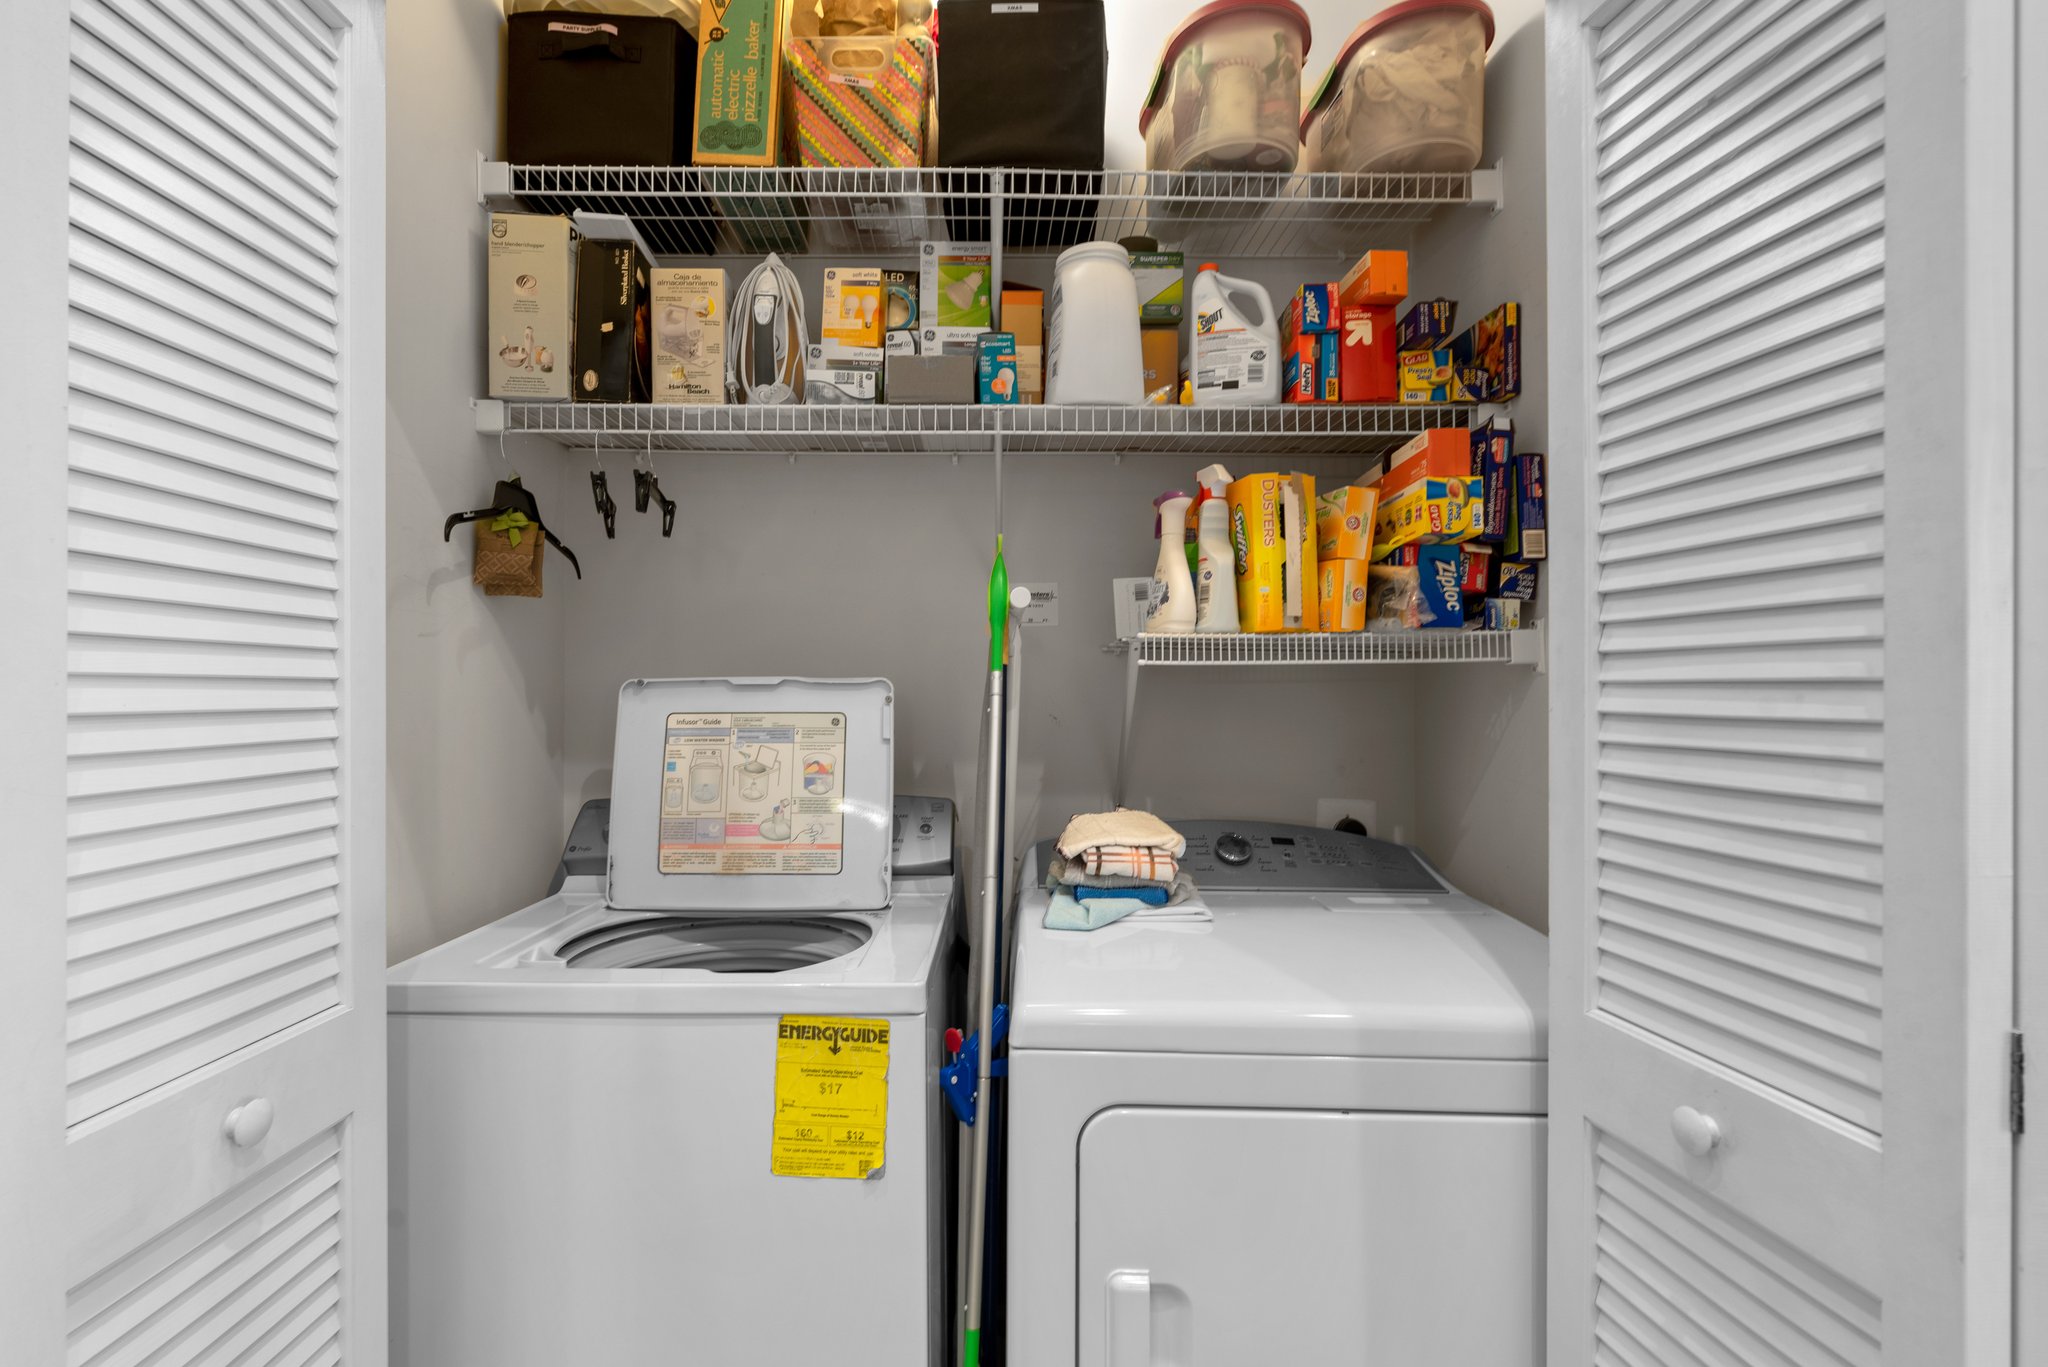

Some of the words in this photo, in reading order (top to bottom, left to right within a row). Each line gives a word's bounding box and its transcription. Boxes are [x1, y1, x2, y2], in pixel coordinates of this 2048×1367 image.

[562, 24, 580, 32] PARTY
[744, 19, 760, 60] baker
[711, 49, 725, 119] automatic
[724, 69, 741, 120] electric
[741, 66, 759, 122] pizzelle
[673, 273, 690, 281] Caja
[885, 272, 905, 283] LED
[1304, 290, 1320, 324] Ziploc
[1200, 307, 1223, 331] SHOUT
[887, 342, 903, 350] reveal
[1404, 353, 1428, 365] GLAD
[1302, 364, 1312, 393] Hefty
[1405, 392, 1418, 400] 140
[1261, 479, 1275, 548] DUSTERS
[1430, 505, 1441, 532] GLAD
[1233, 503, 1248, 575] Swiffer
[1434, 559, 1461, 612] Ziploc
[702, 717, 722, 726] Guide
[778, 1023, 890, 1045] ENERGYGUIDE
[819, 1081, 843, 1096] $17
[846, 1129, 865, 1141] $12
[807, 1148, 823, 1156] depend
